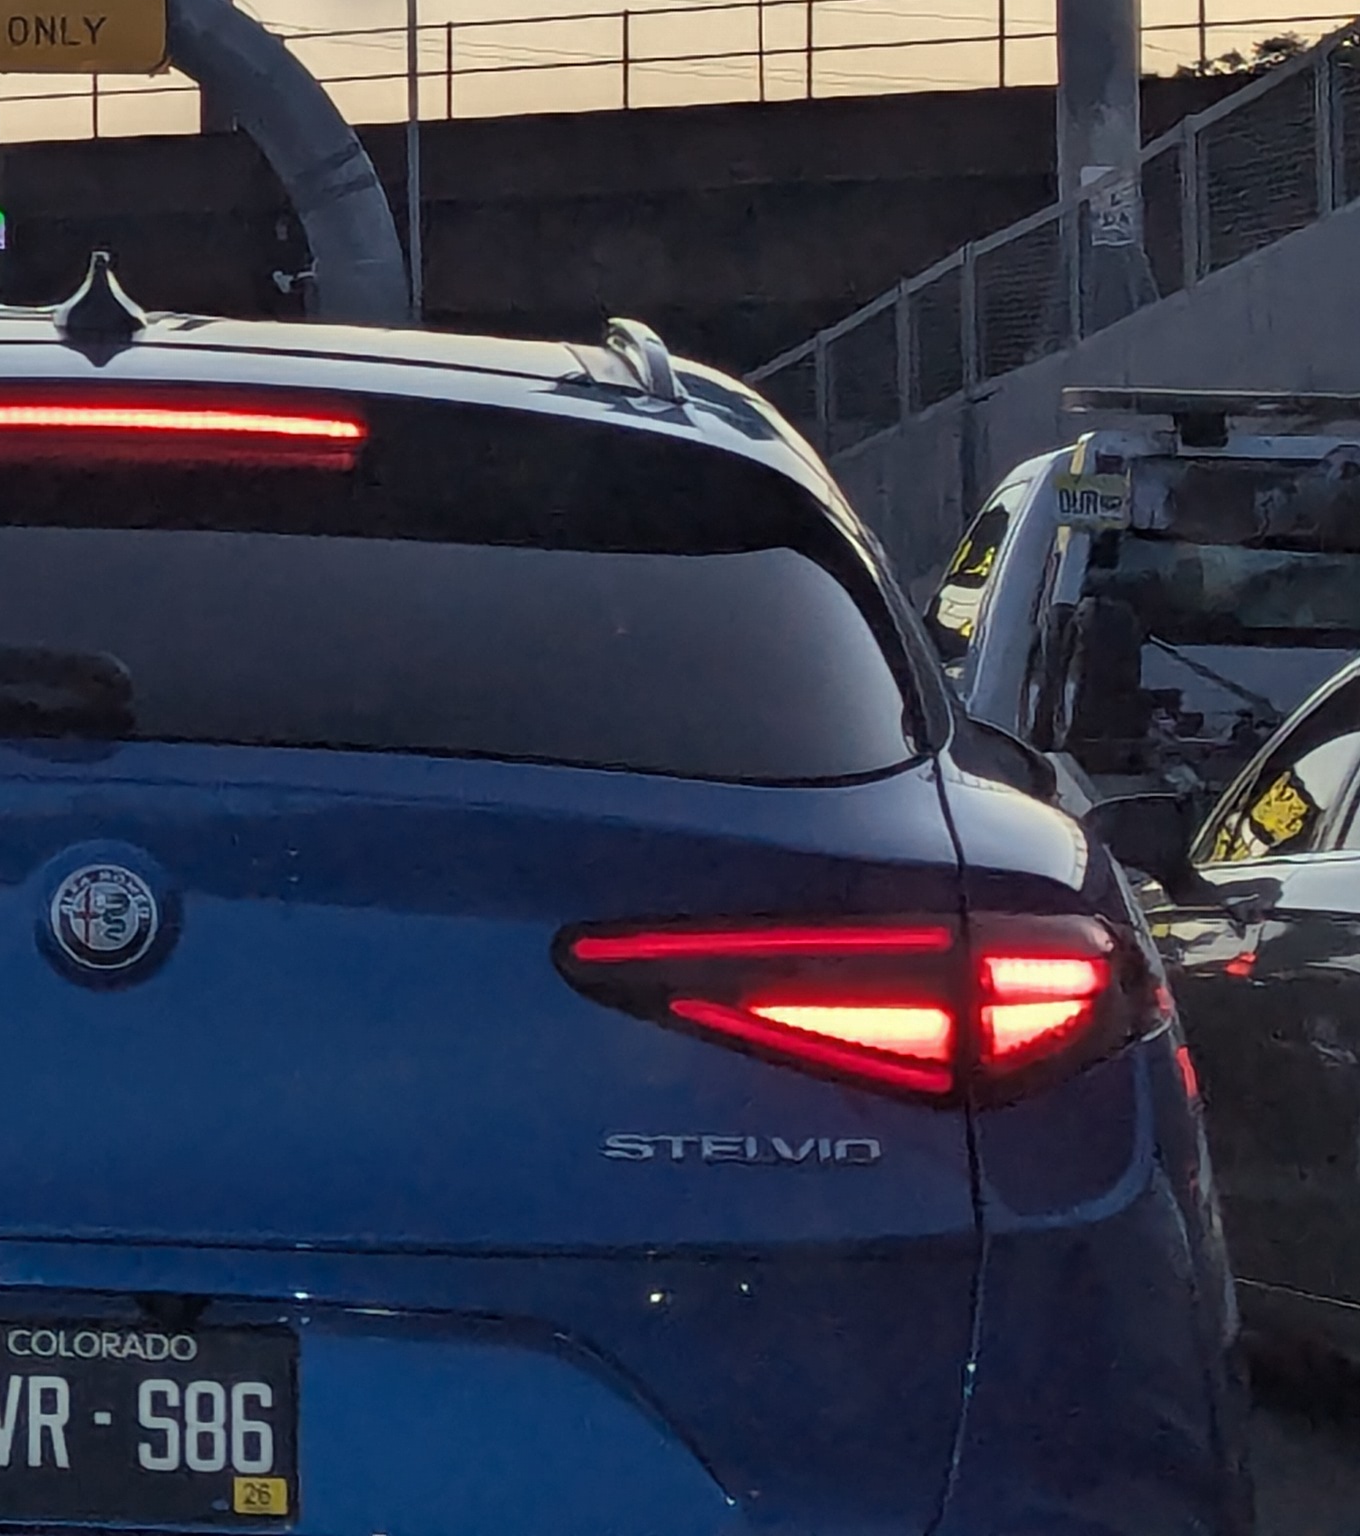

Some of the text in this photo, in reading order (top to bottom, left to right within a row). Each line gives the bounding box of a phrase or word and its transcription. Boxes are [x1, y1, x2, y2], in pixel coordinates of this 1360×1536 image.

[7, 15, 108, 47] ONLY
[601, 1132, 881, 1163] STELVIO
[7, 1328, 199, 1362] COLORADO
[241, 1481, 273, 1507] 26
